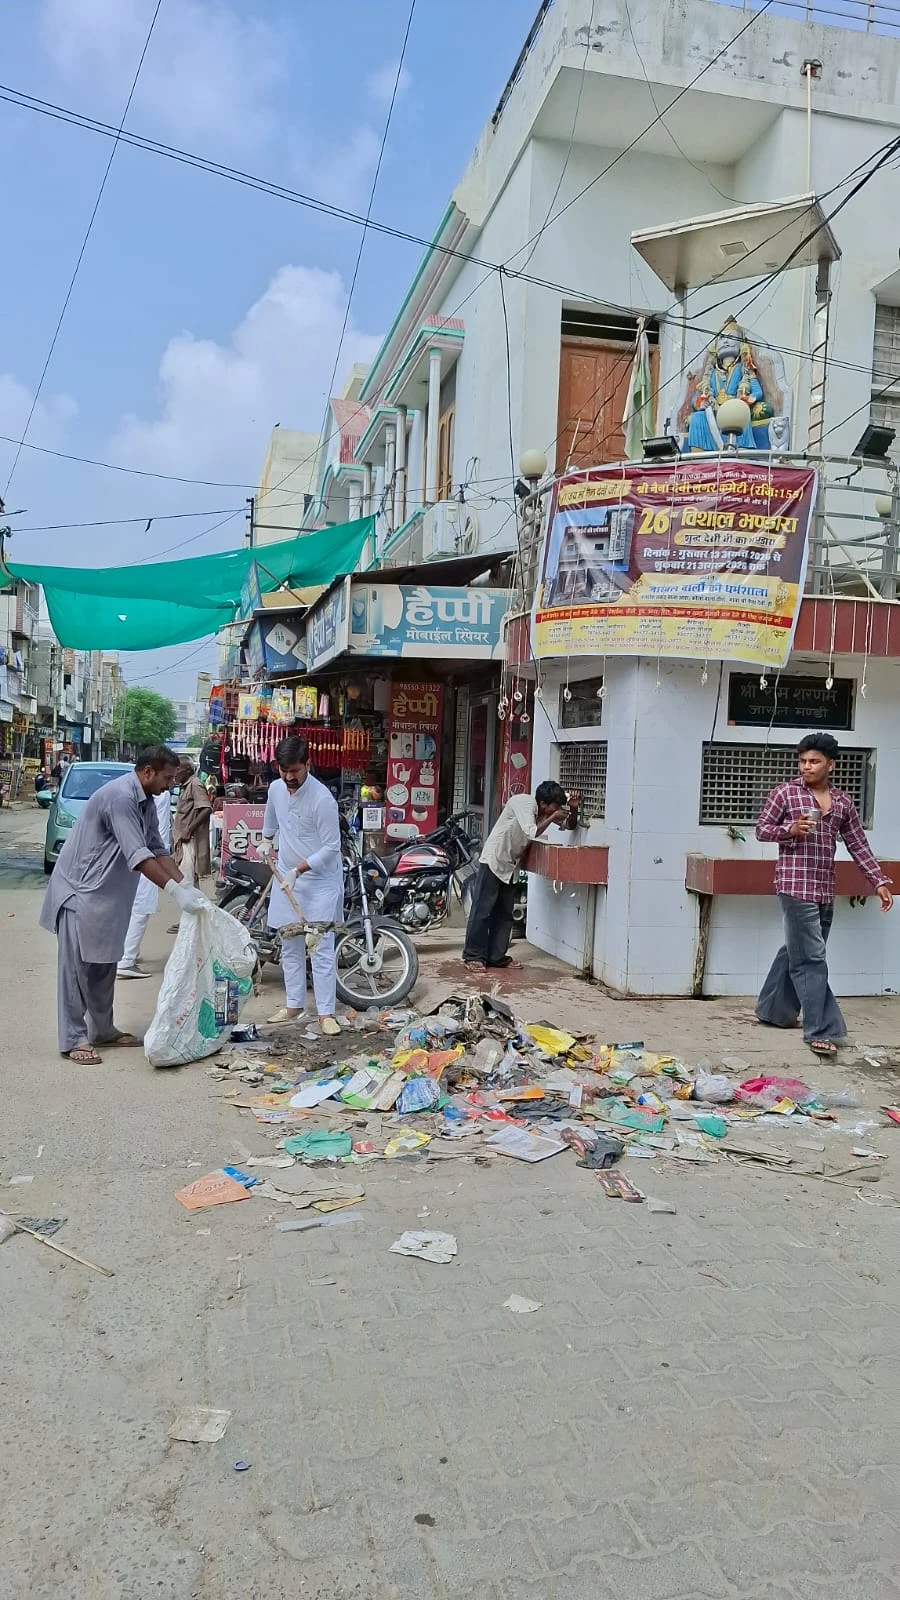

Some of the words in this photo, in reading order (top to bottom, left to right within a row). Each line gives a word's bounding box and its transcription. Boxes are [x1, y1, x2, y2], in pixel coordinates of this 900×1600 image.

[680, 506, 737, 529] विशाल
[738, 513, 799, 533] भण्डारा
[725, 583, 769, 597] धर्मशाला
[405, 587, 496, 625] हैप्पी
[455, 627, 490, 644] रिपेयर
[392, 691, 439, 717] हैप्पी
[764, 686, 791, 701] रम
